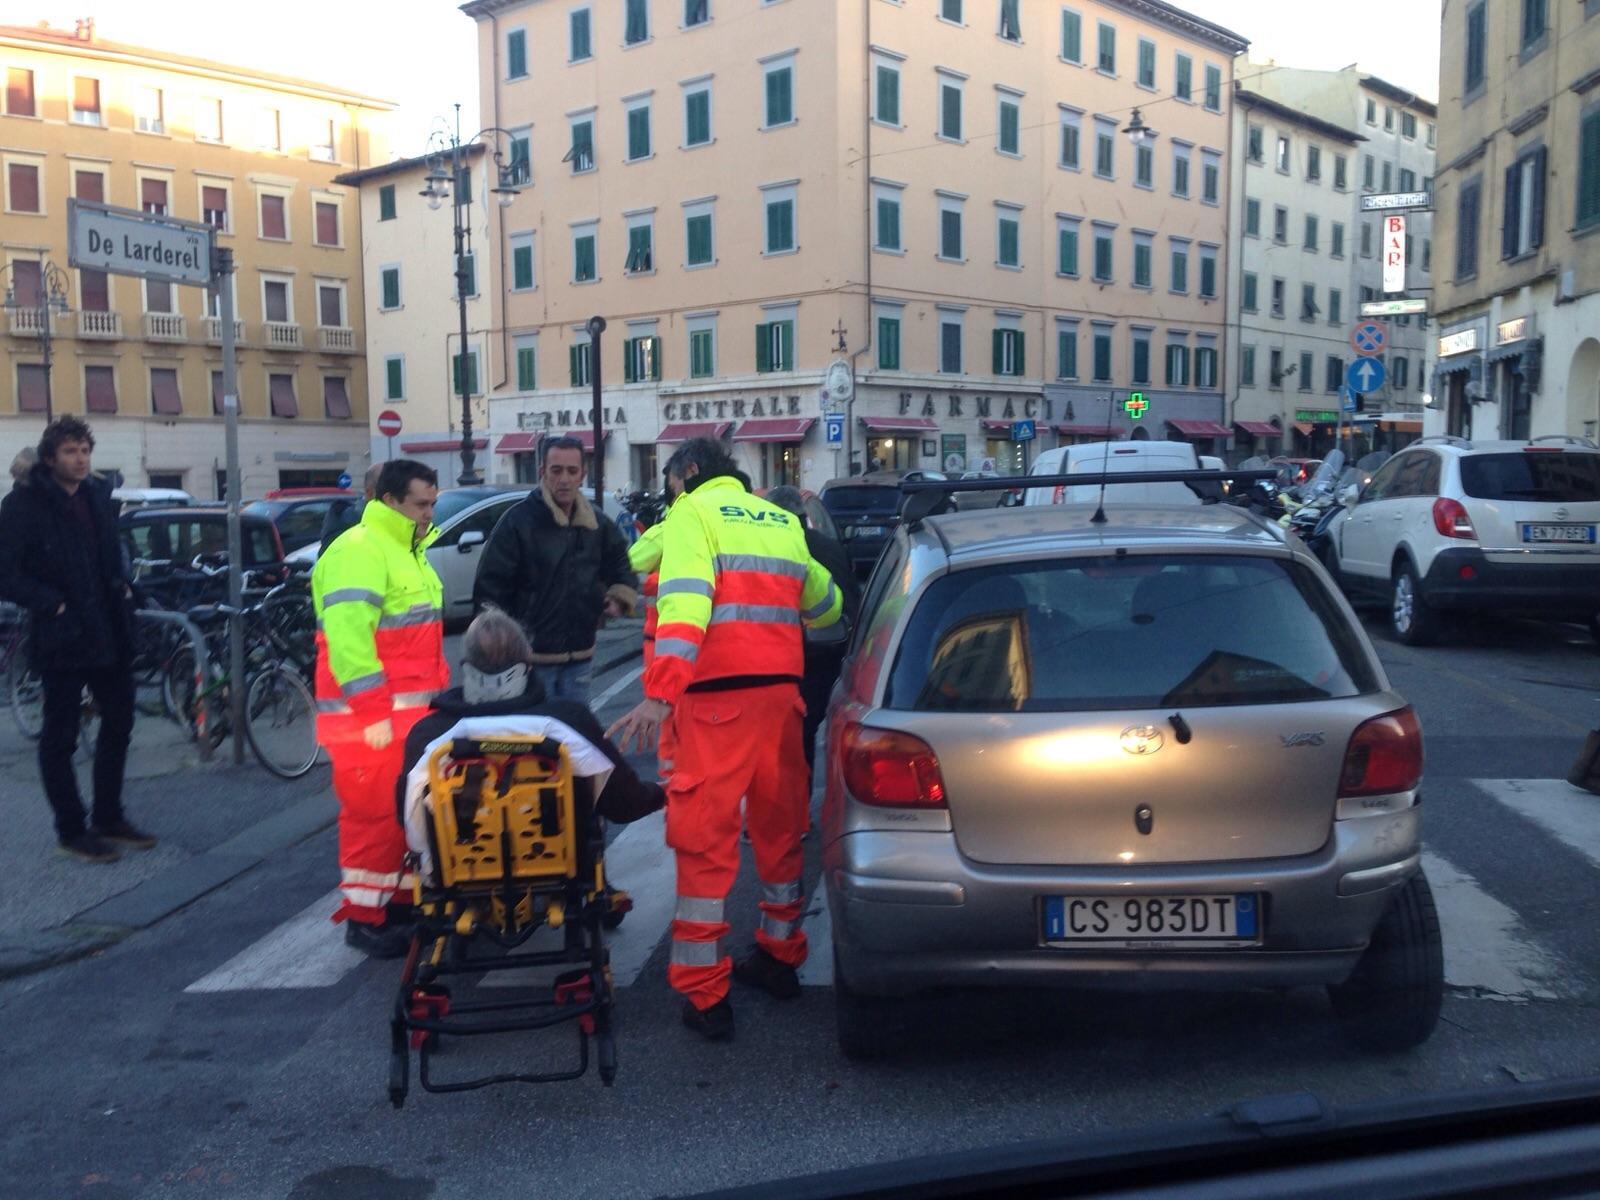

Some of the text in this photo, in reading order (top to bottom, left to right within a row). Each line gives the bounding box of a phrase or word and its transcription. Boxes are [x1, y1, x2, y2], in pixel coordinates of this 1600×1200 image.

[88, 228, 200, 270] De Larderel
[186, 235, 199, 245] via
[1388, 217, 1402, 266] BAR
[516, 396, 802, 429] FRMAIA CENTRALE
[898, 391, 1076, 421] FARMACIA
[829, 423, 840, 441] P
[719, 505, 790, 525] SVS
[1123, 898, 1232, 933] 983DT
